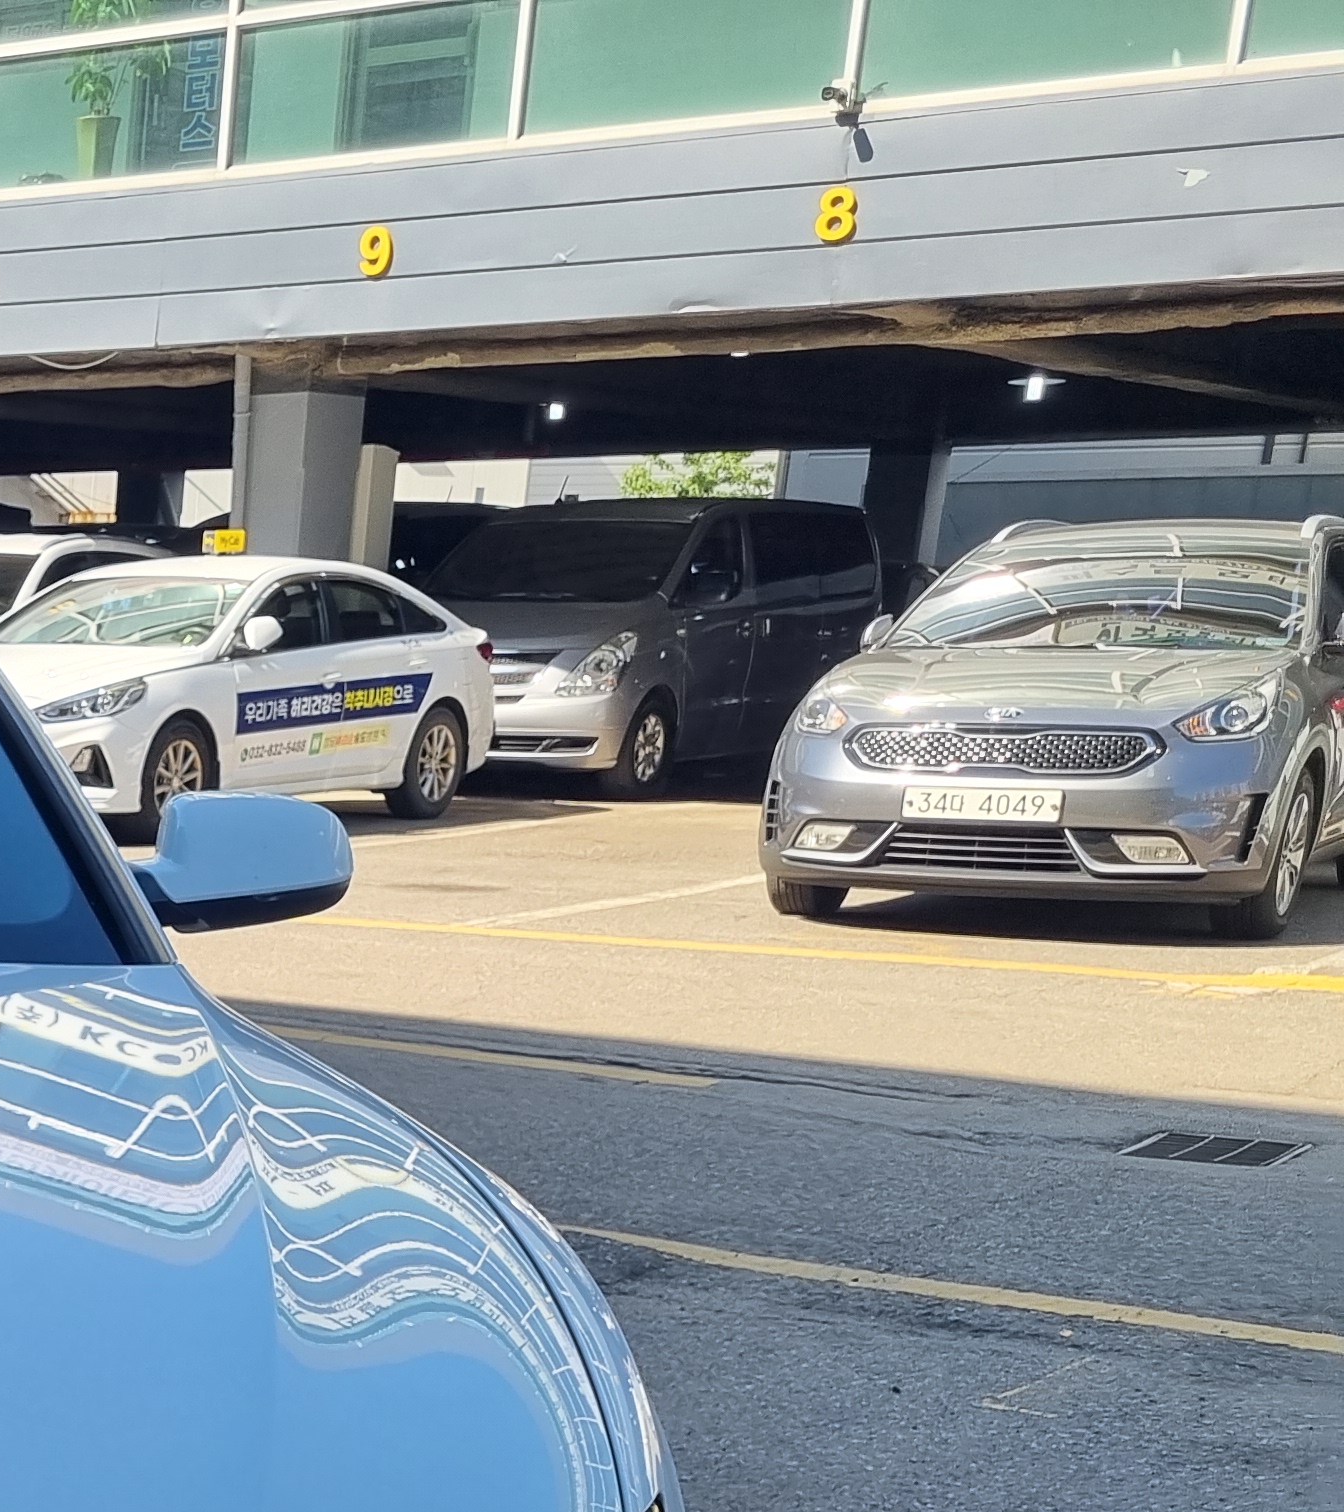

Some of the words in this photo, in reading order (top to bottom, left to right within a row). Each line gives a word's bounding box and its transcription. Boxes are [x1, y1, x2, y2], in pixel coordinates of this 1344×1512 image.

[180, 0, 225, 152] 모터스
[815, 186, 858, 244] 8
[359, 225, 394, 278] 9
[244, 699, 290, 725] 우리가족
[918, 792, 965, 814] 34다
[978, 794, 1045, 816] 4049
